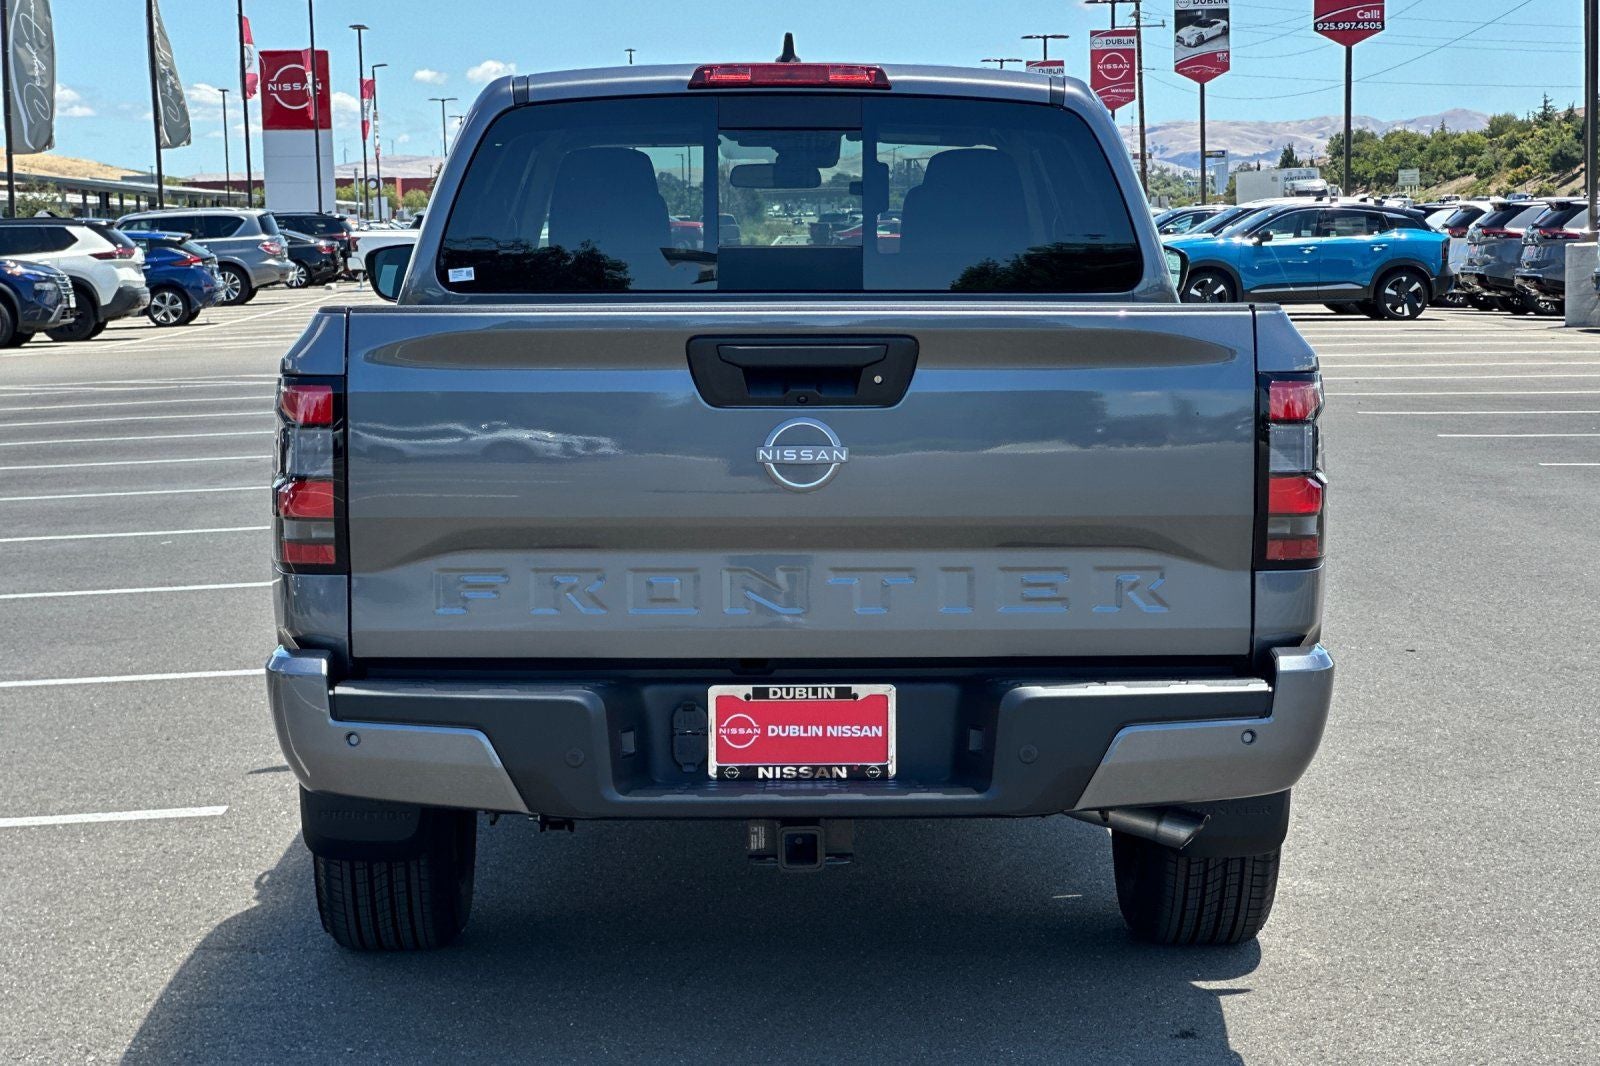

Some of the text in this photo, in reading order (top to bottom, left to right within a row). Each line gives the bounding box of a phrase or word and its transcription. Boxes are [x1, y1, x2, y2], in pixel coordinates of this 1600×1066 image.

[1356, 10, 1380, 19] Call!
[1316, 22, 1382, 31] 925.997.4505
[267, 83, 322, 91] NISSAN
[759, 449, 847, 461] NISSAN
[433, 567, 1169, 615] FRONTIER
[768, 687, 836, 699] DUBLIN
[719, 727, 761, 735] NISSAN
[767, 725, 883, 737] DUBLIN NISSAN
[757, 766, 848, 779] NISSAN
